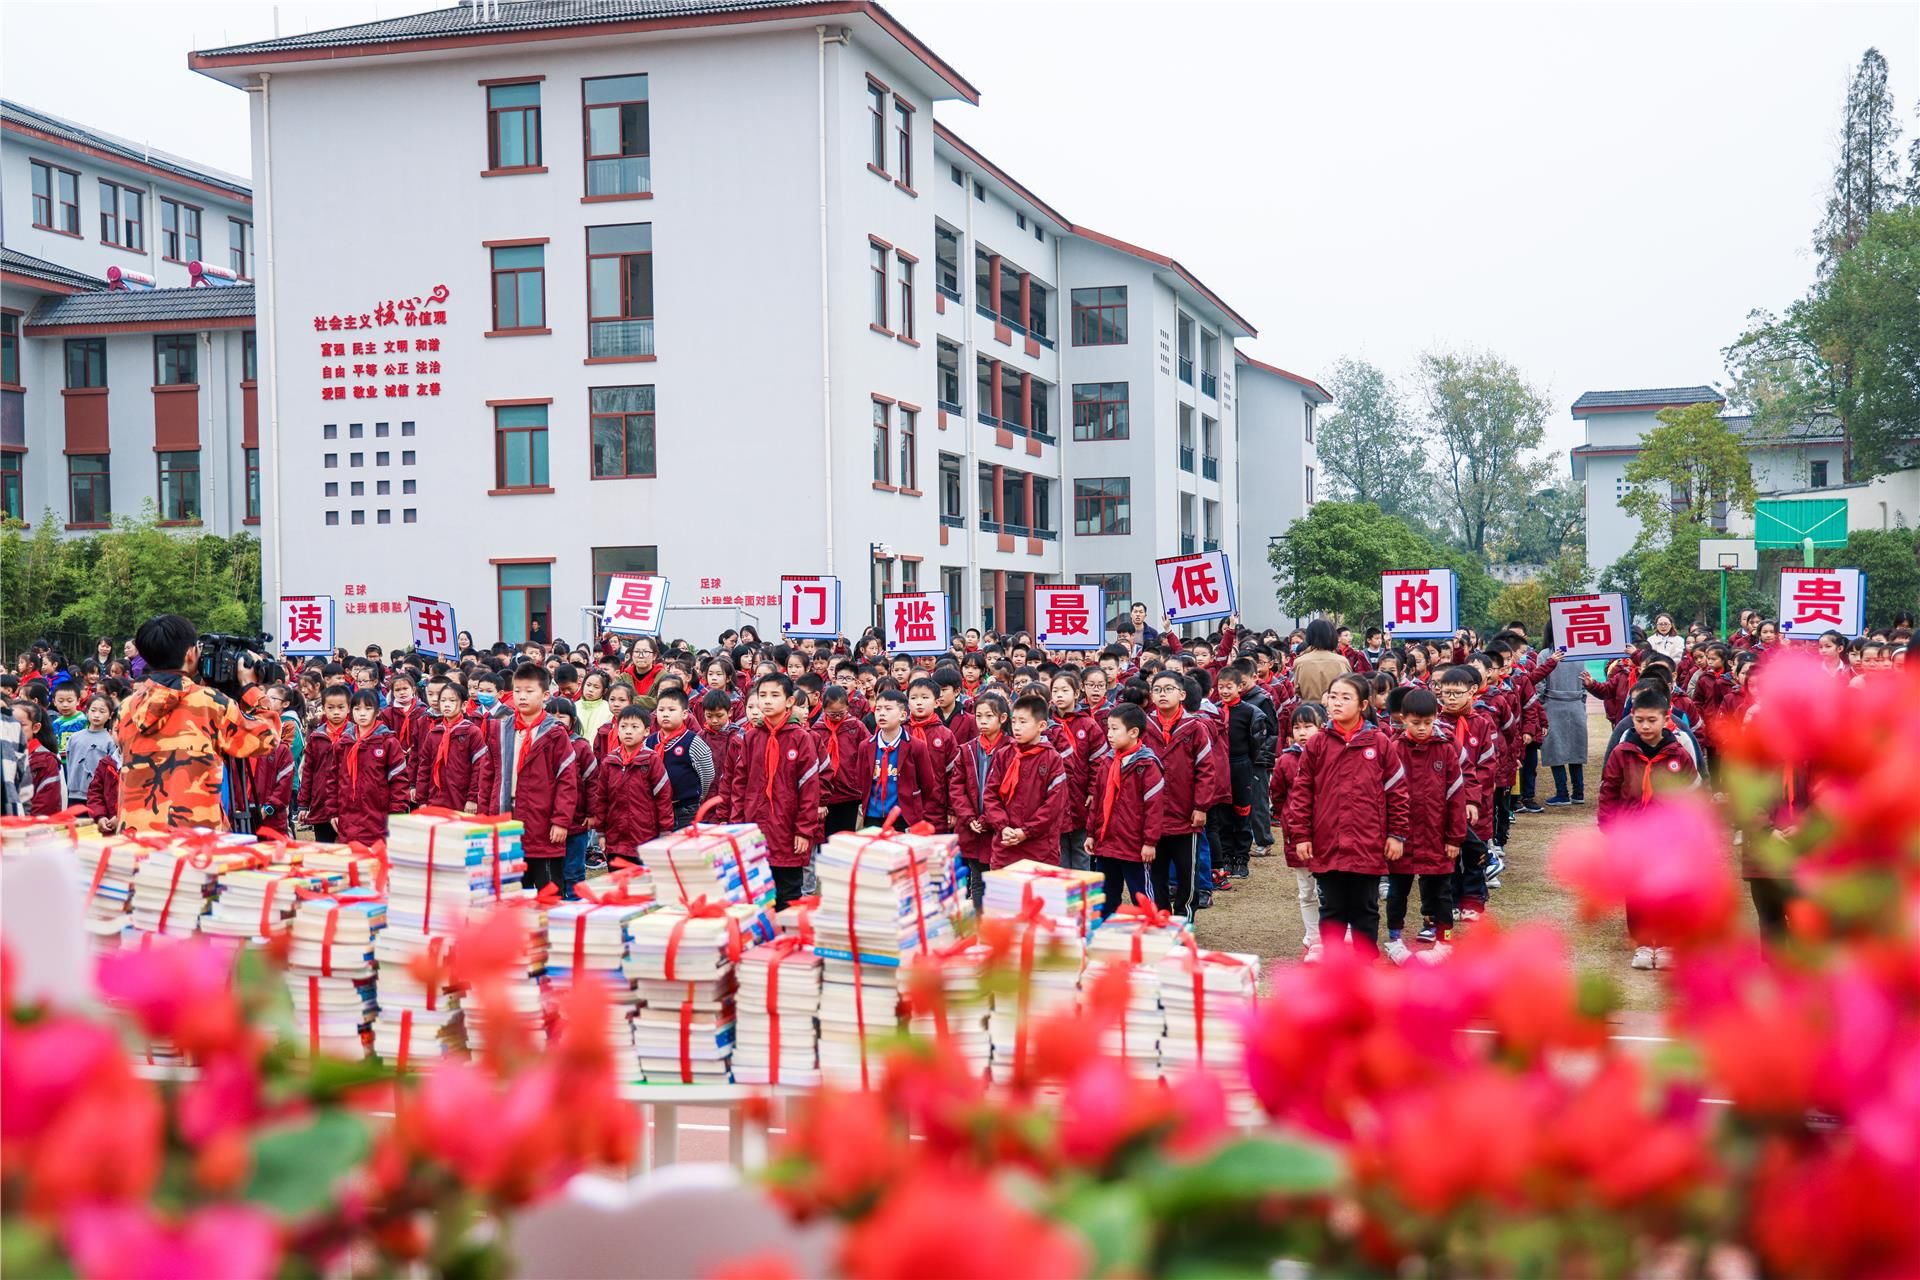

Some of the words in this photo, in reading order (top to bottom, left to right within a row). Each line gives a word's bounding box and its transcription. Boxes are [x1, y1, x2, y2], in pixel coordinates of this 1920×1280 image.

[314, 297, 447, 331] 社会主义核心价值观
[320, 342, 346, 357] 富强
[352, 341, 377, 355] 民主
[384, 339, 409, 354] 文明
[415, 338, 440, 352] 和谐
[322, 365, 346, 379] 自由
[352, 363, 378, 377] 平等
[384, 362, 409, 376] 公正
[416, 360, 441, 375] 法治
[321, 386, 346, 400] 爱国
[353, 385, 378, 399] 敬业
[384, 383, 410, 398] 诚信
[416, 382, 441, 396] 友善
[345, 584, 367, 596] 足球
[614, 582, 653, 621] 是
[700, 578, 721, 590] 足球
[1172, 561, 1219, 609] 低
[1395, 580, 1439, 624] 的
[1793, 578, 1845, 625] 贵
[289, 604, 322, 643] 读
[792, 584, 827, 625] 门
[894, 601, 937, 643] 槛
[1046, 594, 1090, 636] 最
[418, 607, 447, 645] 书
[1561, 603, 1612, 649] 高
